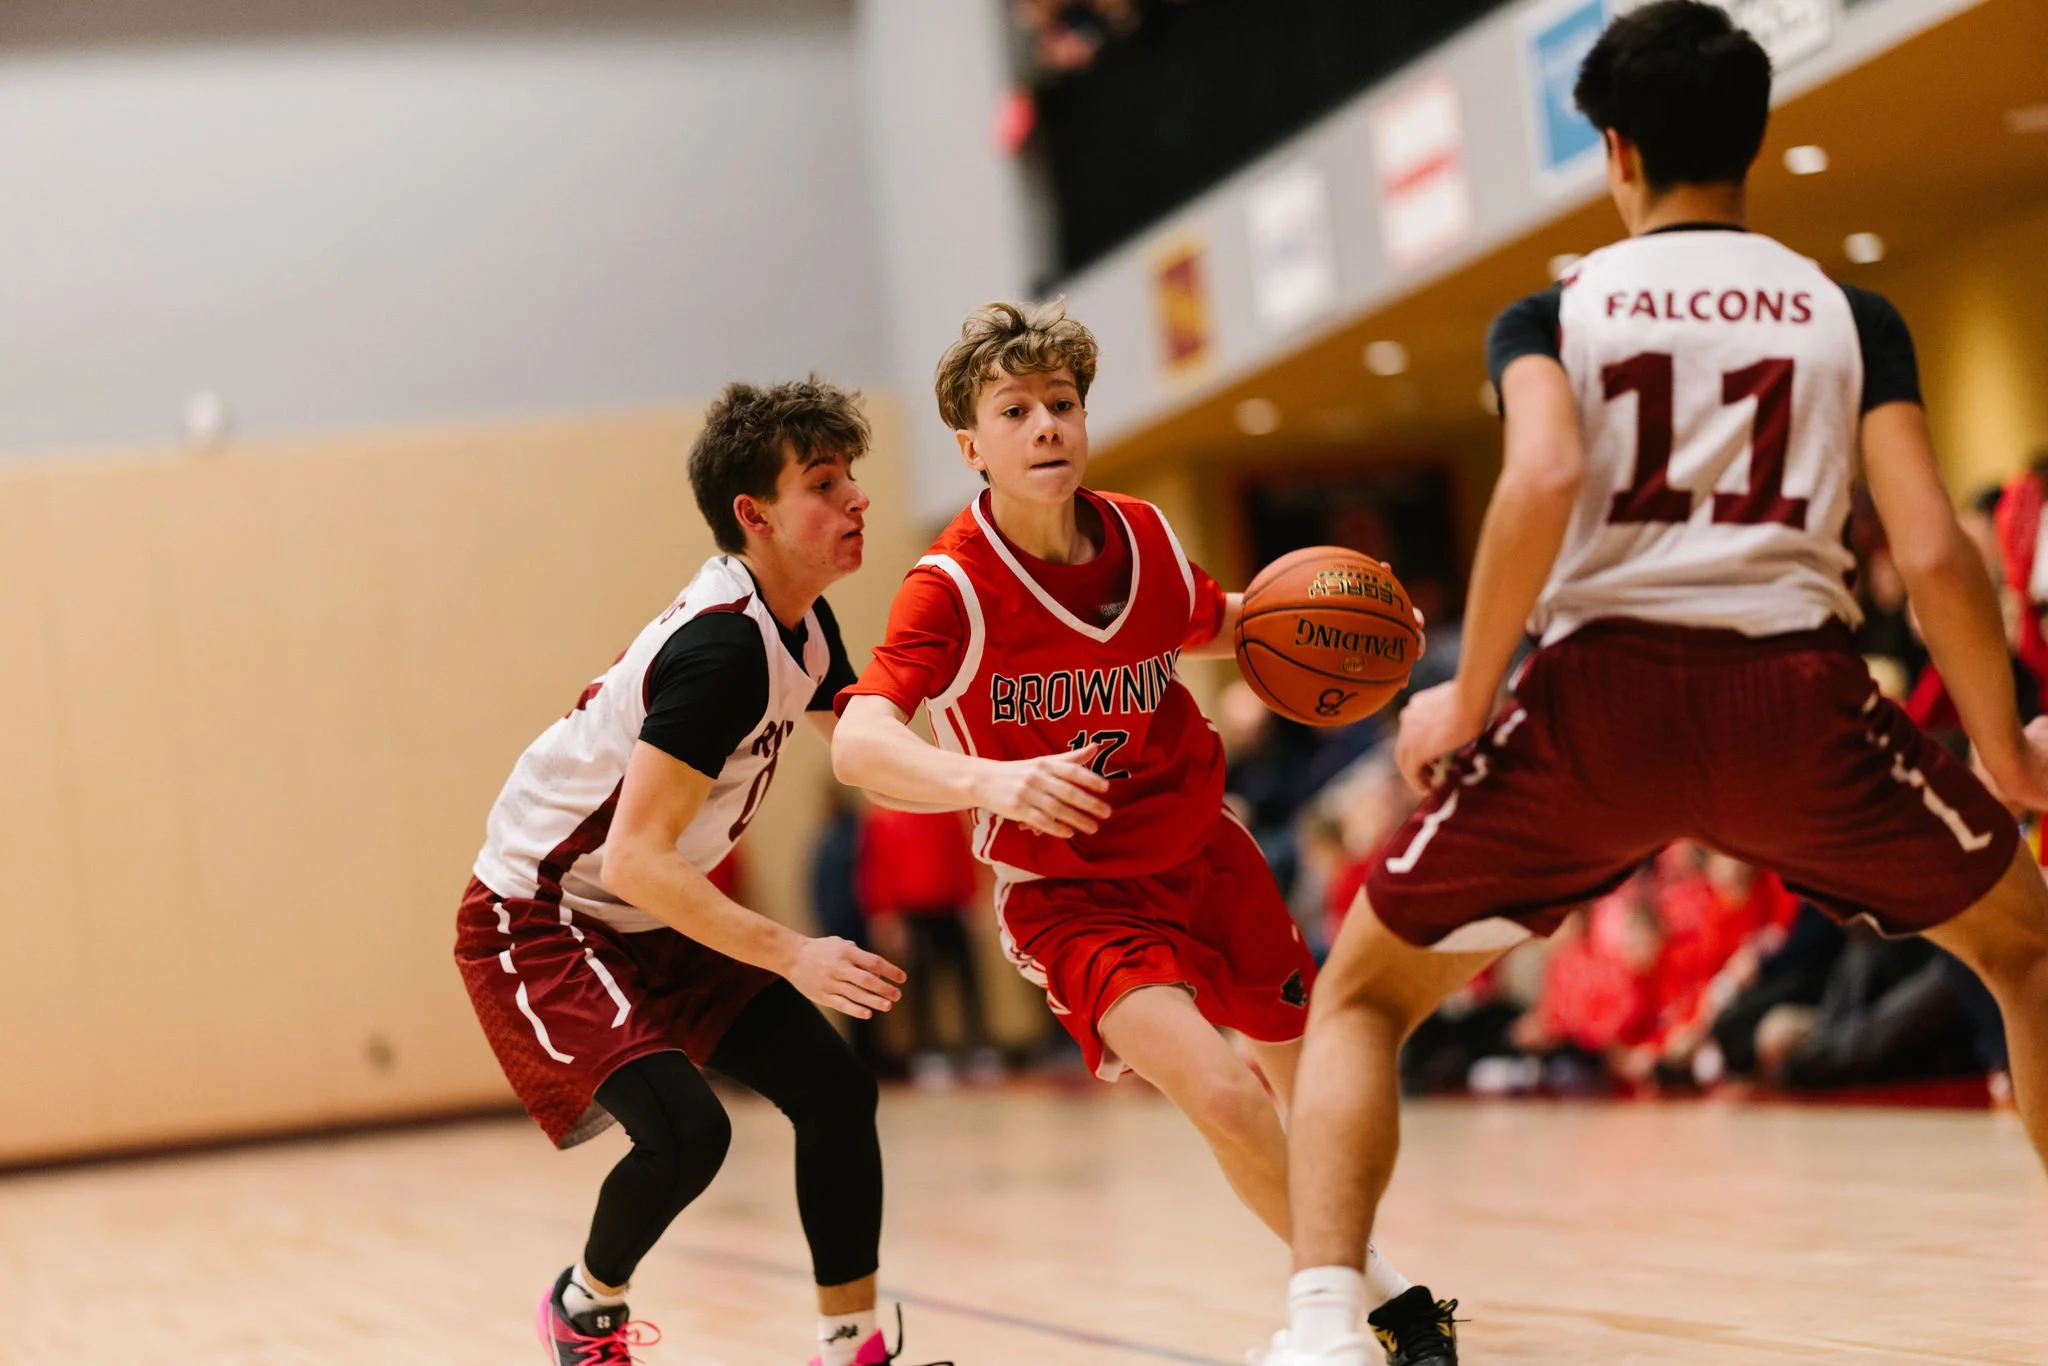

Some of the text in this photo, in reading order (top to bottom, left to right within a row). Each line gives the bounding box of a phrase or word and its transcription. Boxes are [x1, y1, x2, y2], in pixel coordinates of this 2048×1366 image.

[1605, 289, 1814, 324] FALCONS
[1601, 351, 1810, 531] 11
[1307, 578, 1405, 613] LEGACY
[1295, 617, 1409, 664] SPALDING
[990, 646, 1183, 726] BROWNIN
